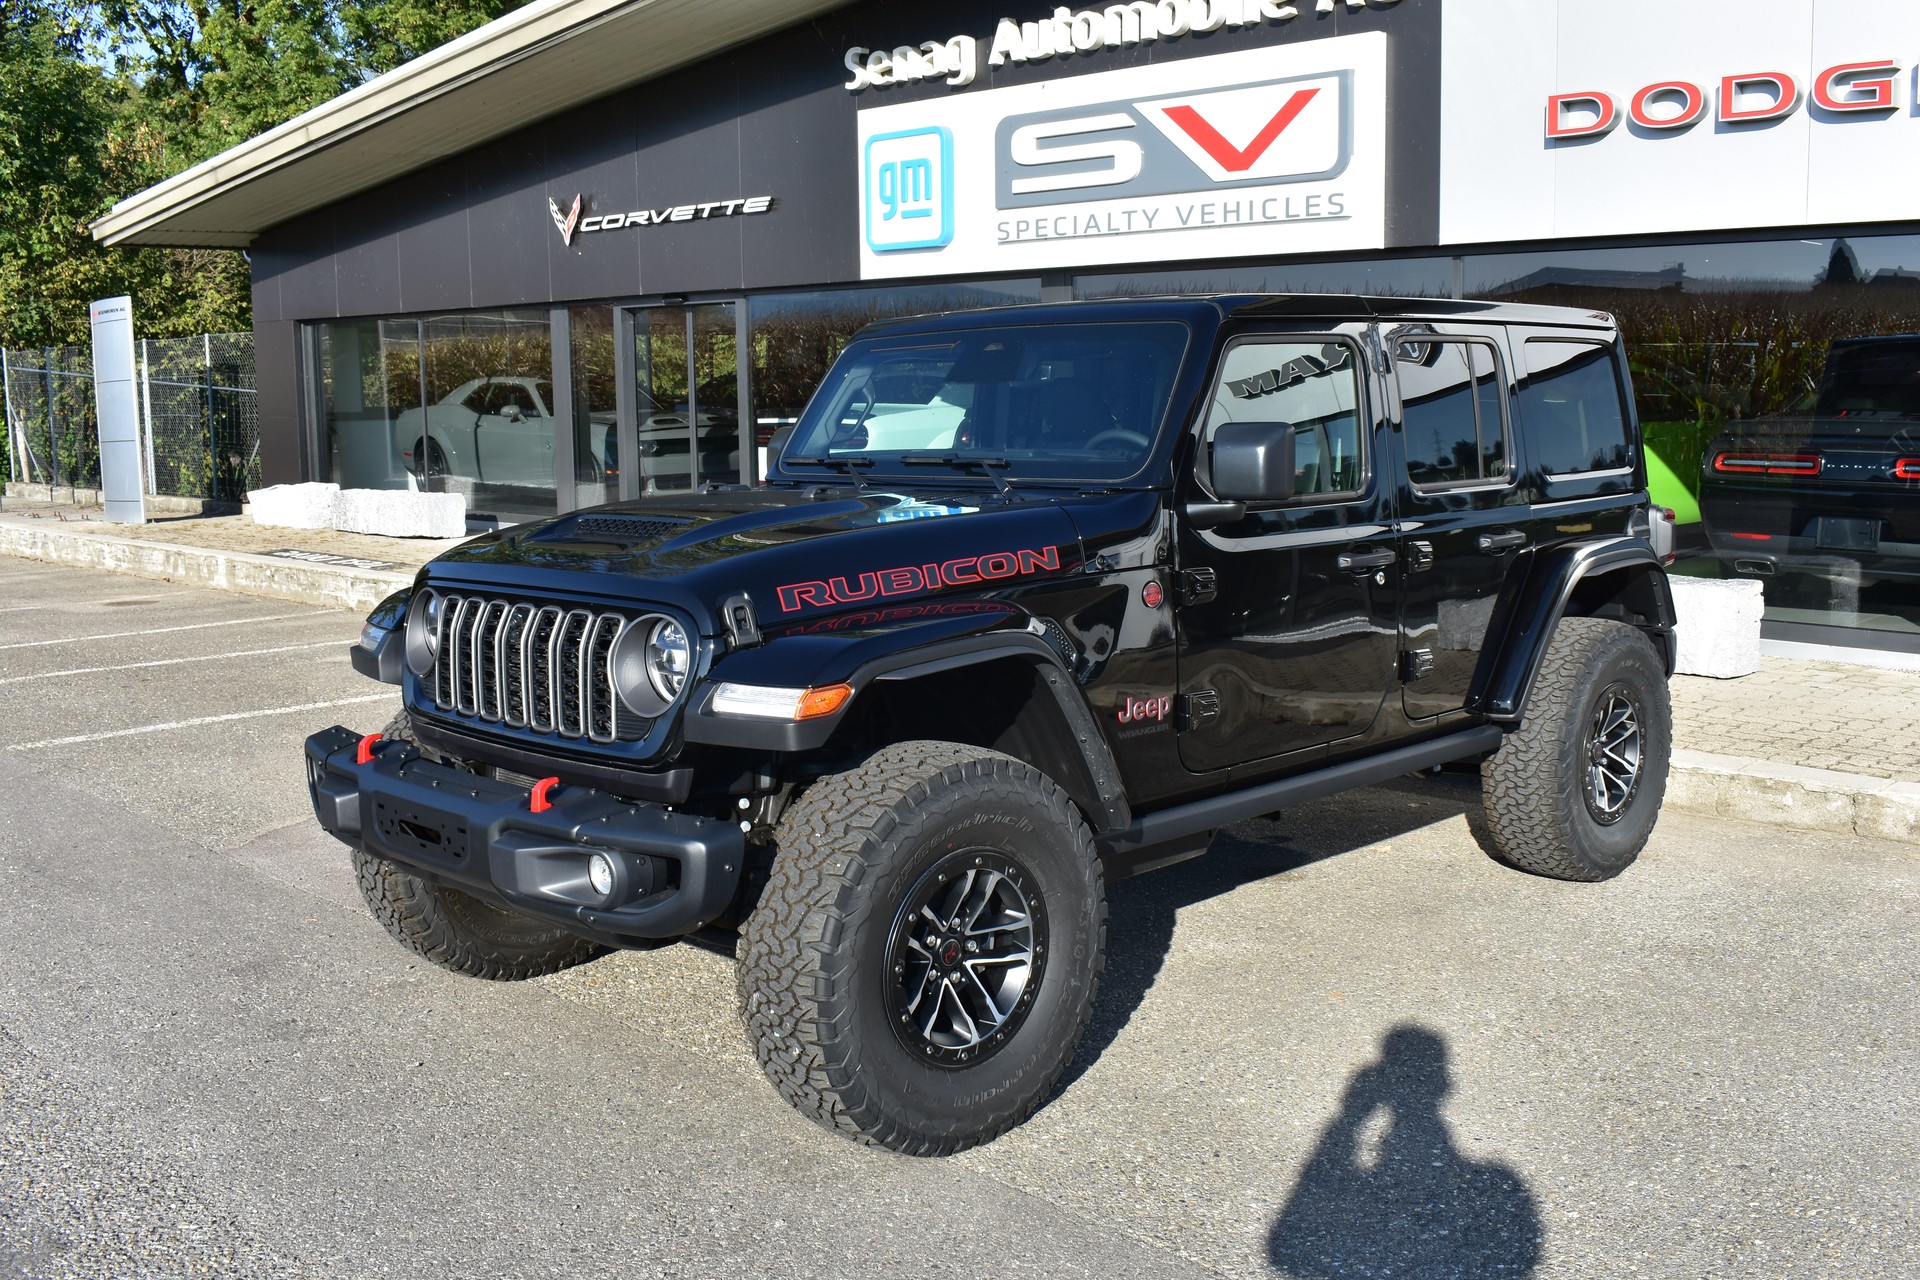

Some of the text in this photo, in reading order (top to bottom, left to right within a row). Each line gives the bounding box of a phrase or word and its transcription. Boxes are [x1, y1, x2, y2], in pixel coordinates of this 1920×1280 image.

[844, 34, 977, 90] Senag
[1545, 59, 1920, 139] DODG
[580, 195, 772, 232] CORVETTE
[879, 157, 933, 221] gm
[997, 193, 1345, 241] SPECIALTY VEHICLES
[776, 545, 1061, 613] RUBICON
[1118, 695, 1171, 723] Jeep
